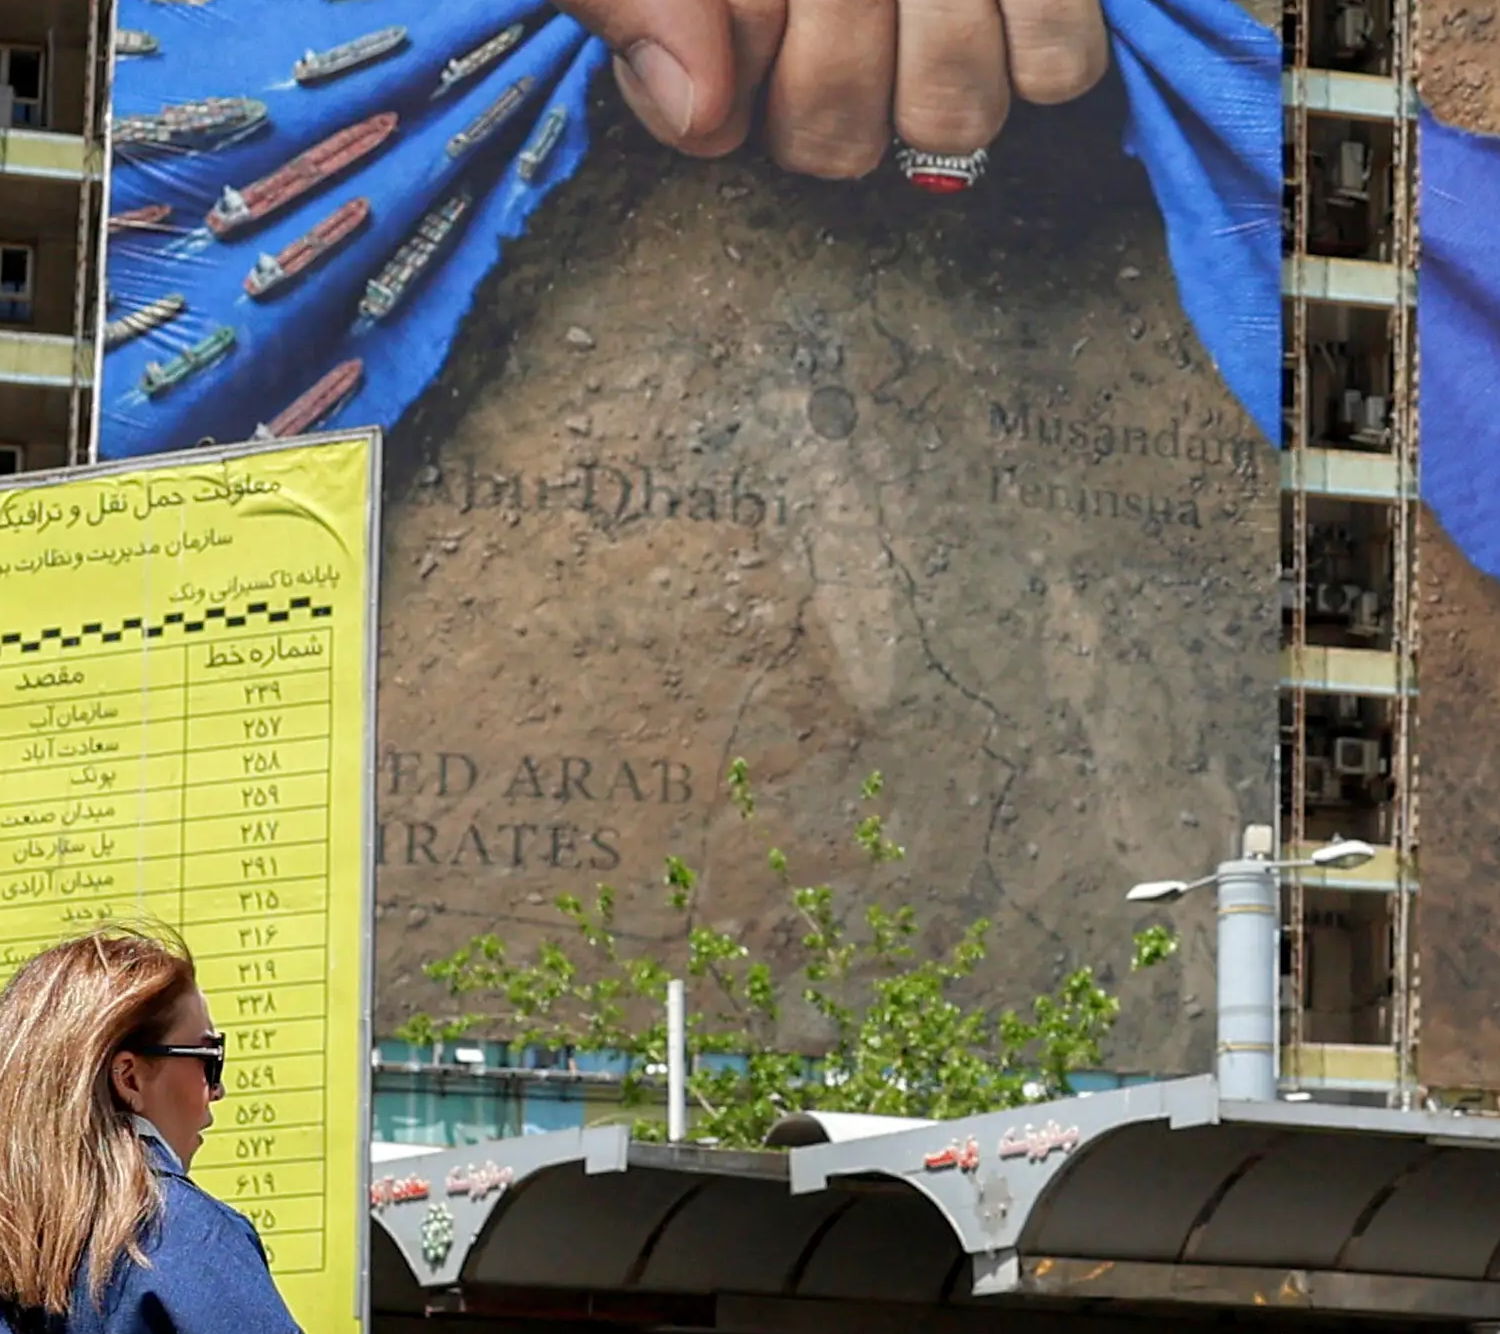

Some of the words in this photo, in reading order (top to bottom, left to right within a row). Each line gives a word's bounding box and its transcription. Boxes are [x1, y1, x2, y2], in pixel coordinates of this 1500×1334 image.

[134, 485, 186, 520] حمل
[164, 528, 233, 557] سازمان
[296, 564, 341, 591] پایانه
[168, 583, 206, 606] ونک
[203, 643, 246, 669] خط
[249, 634, 324, 669] شماره
[15, 666, 85, 691] مقصد
[29, 705, 54, 729] آب
[57, 700, 118, 728] سازمان
[243, 717, 282, 739] ۲۵۷
[243, 751, 281, 773] ۲۵۸
[501, 754, 694, 805] ARAB
[242, 785, 279, 806] ۲۵۹
[0, 809, 56, 830] صنعت
[62, 802, 115, 826] میدان
[240, 821, 279, 843] ۲۸۷
[91, 832, 115, 858] پل
[376, 819, 622, 870] IRATES
[241, 856, 278, 879] ۲۹۱
[1, 868, 54, 902] آزادی
[61, 870, 114, 894] میدان
[249, 1208, 276, 1229] ۲۵
